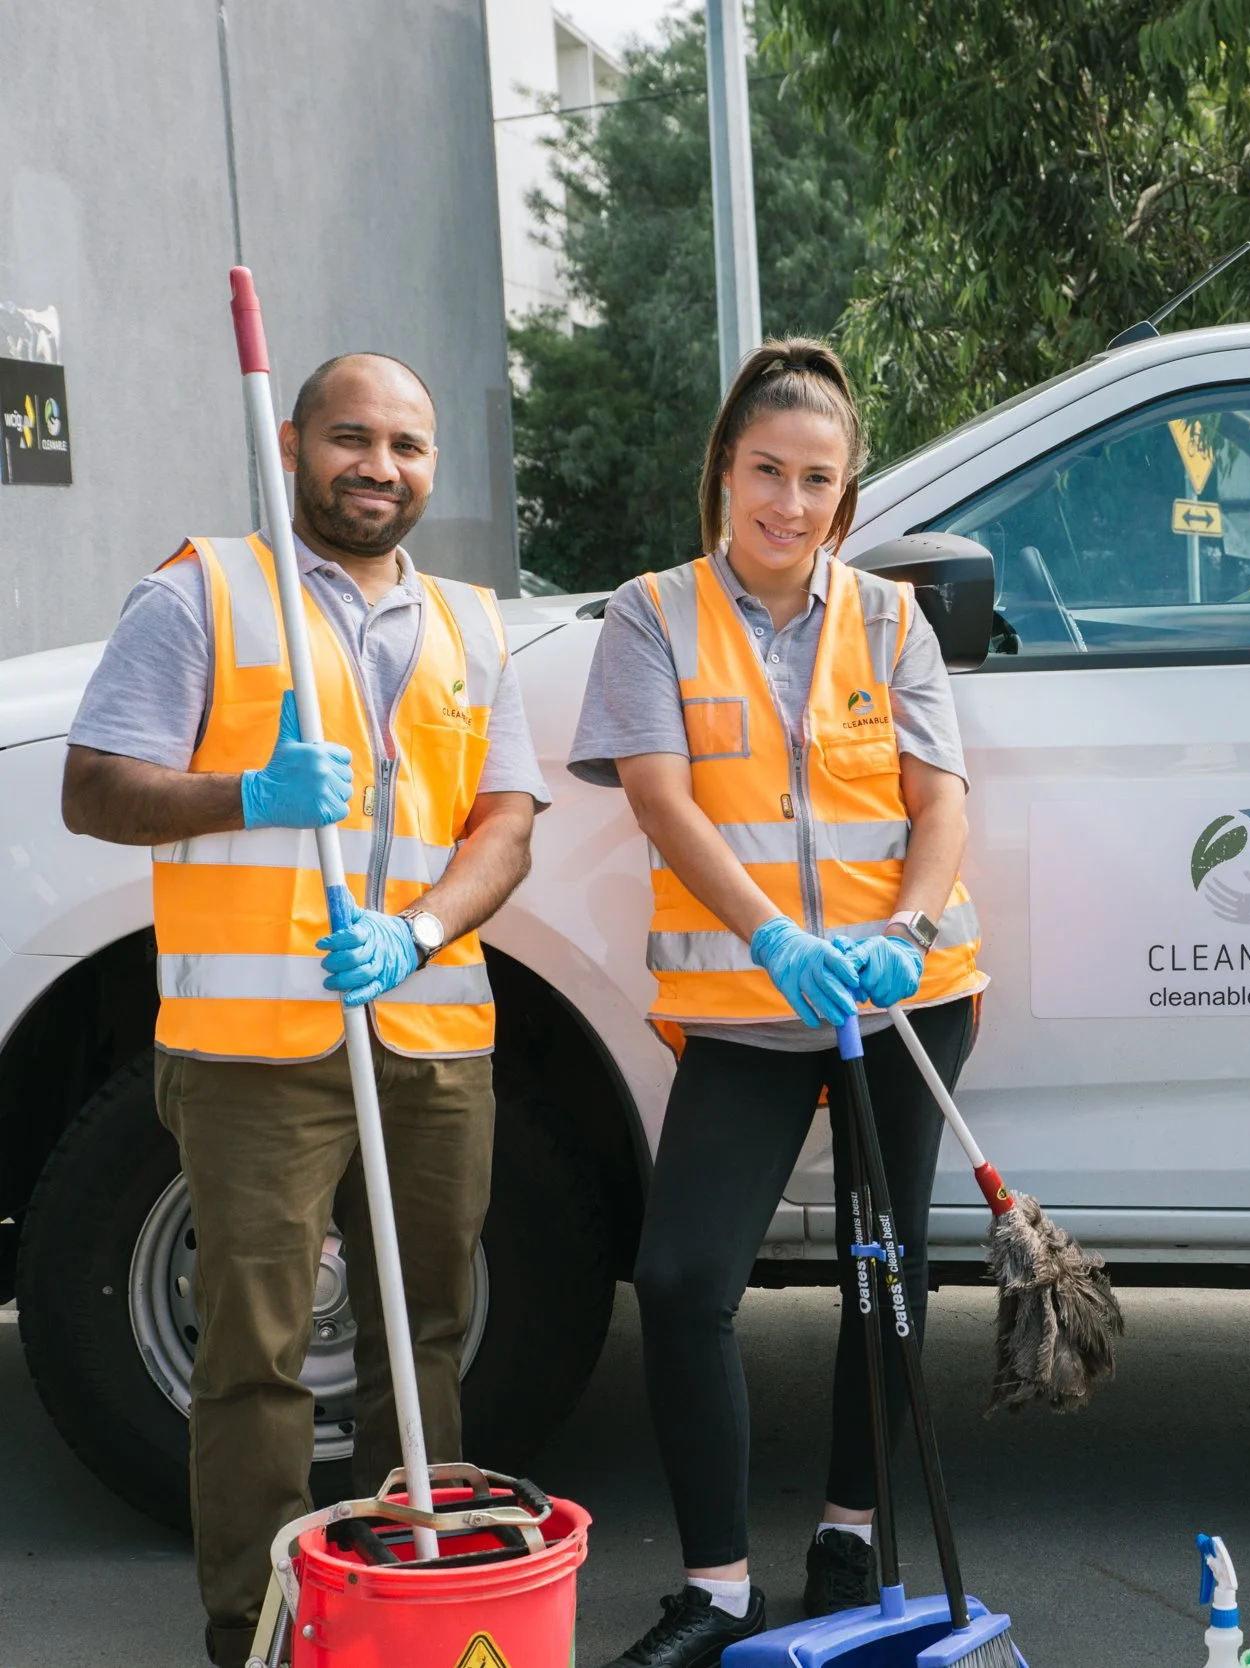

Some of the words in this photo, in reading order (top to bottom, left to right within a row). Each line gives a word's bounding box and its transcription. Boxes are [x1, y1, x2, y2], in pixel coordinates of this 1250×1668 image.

[842, 716, 889, 729] CLEANABLE
[878, 1214, 893, 1239] best!
[885, 1241, 899, 1273] cleans
[857, 1260, 872, 1314] Oates
[891, 1282, 910, 1338] Oates
